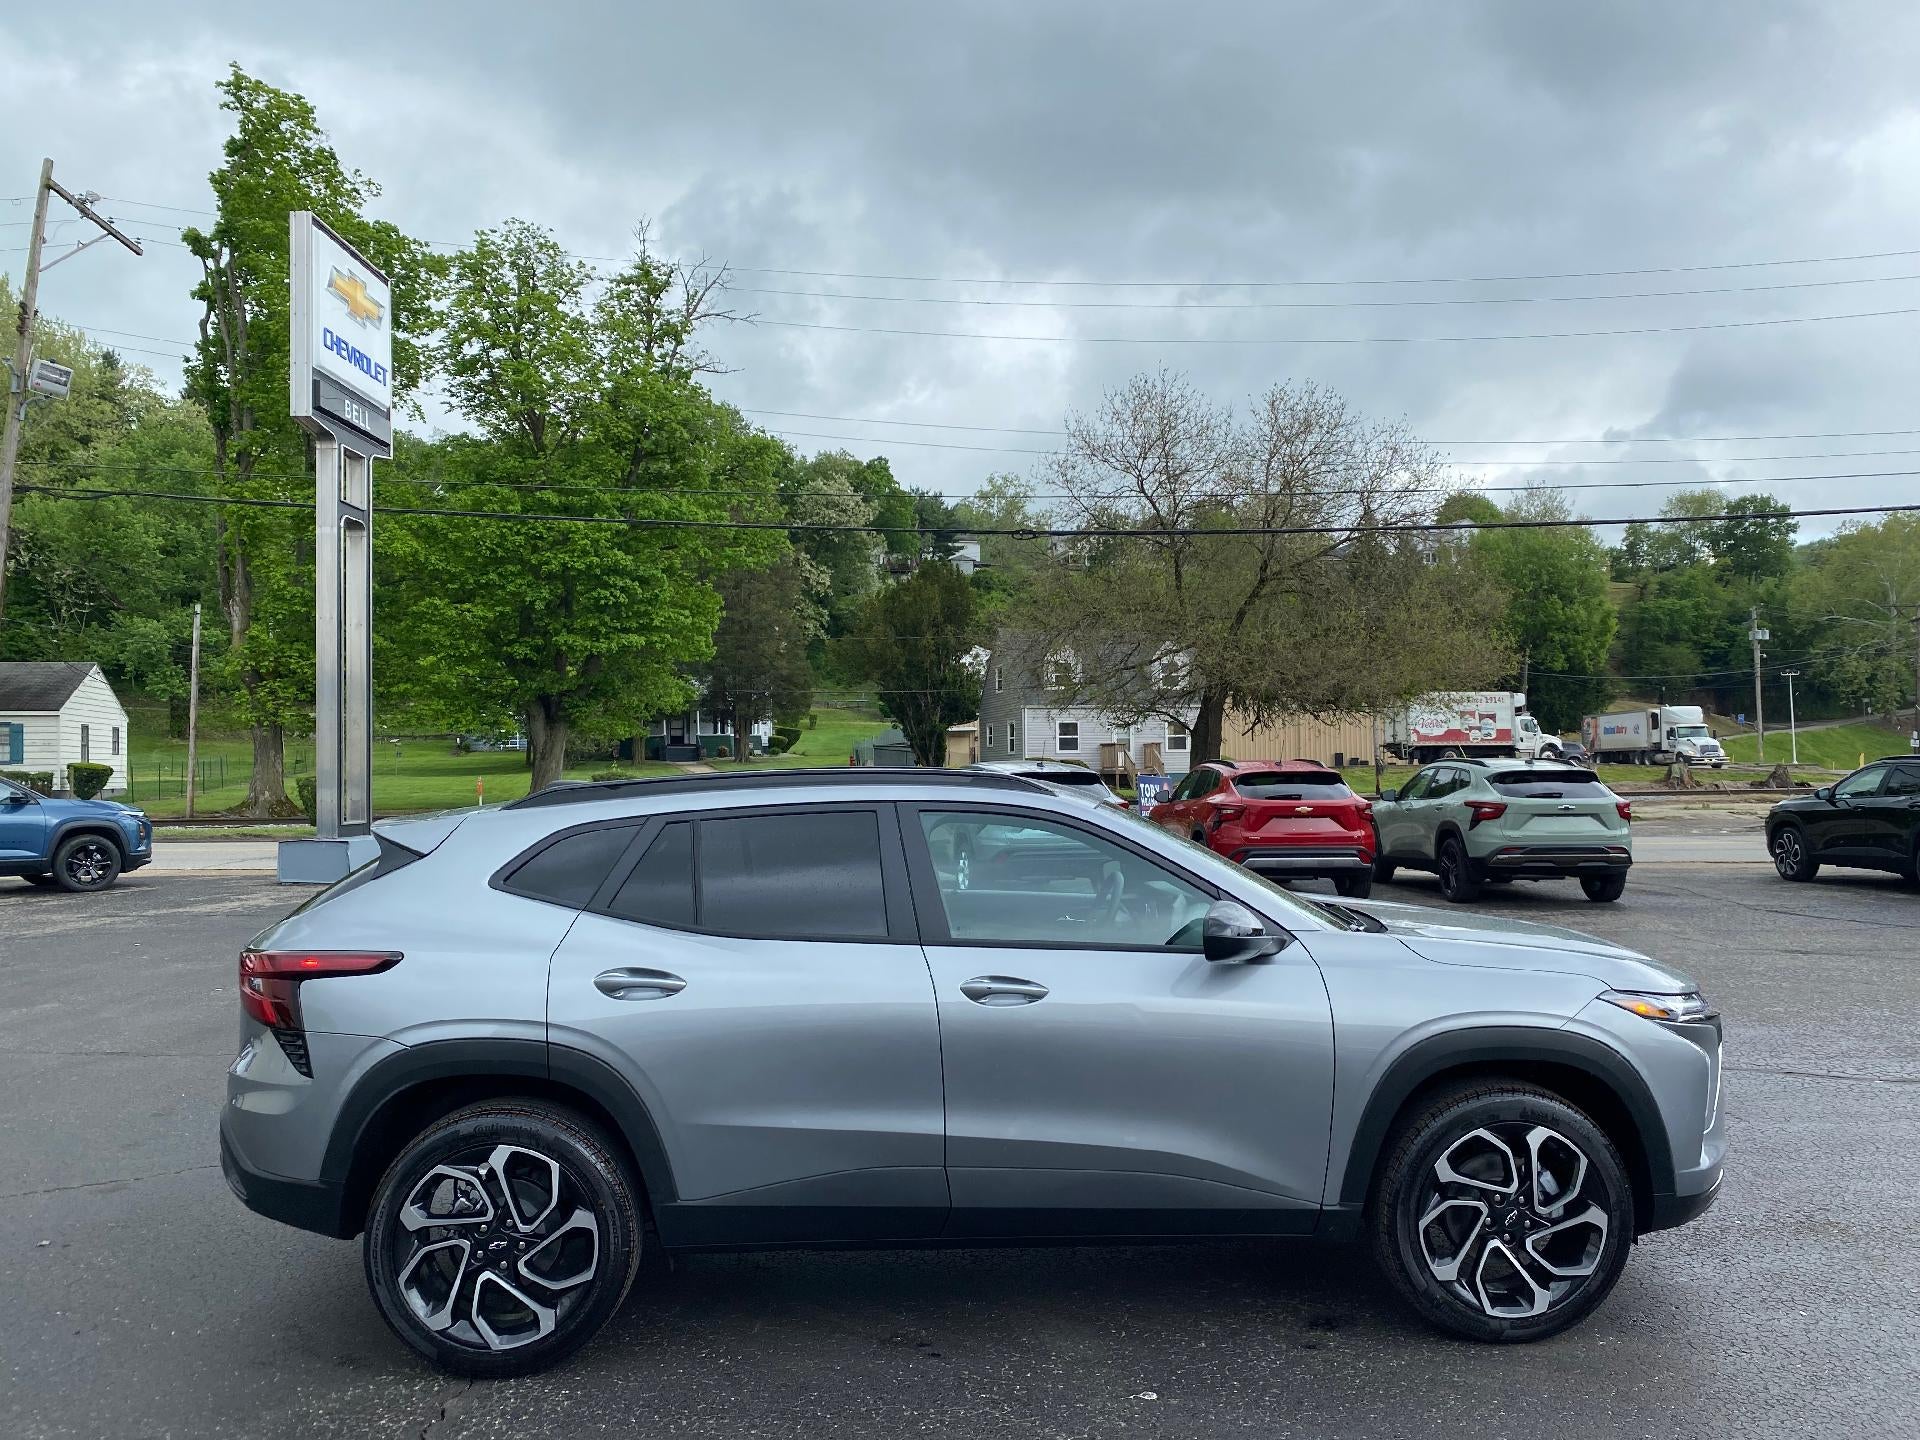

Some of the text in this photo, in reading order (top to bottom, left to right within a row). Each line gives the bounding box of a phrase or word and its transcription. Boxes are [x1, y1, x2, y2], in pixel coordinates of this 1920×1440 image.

[323, 327, 388, 387] CHEVROLET
[344, 399, 371, 430] BELL
[1140, 783, 1160, 797] TOBY
